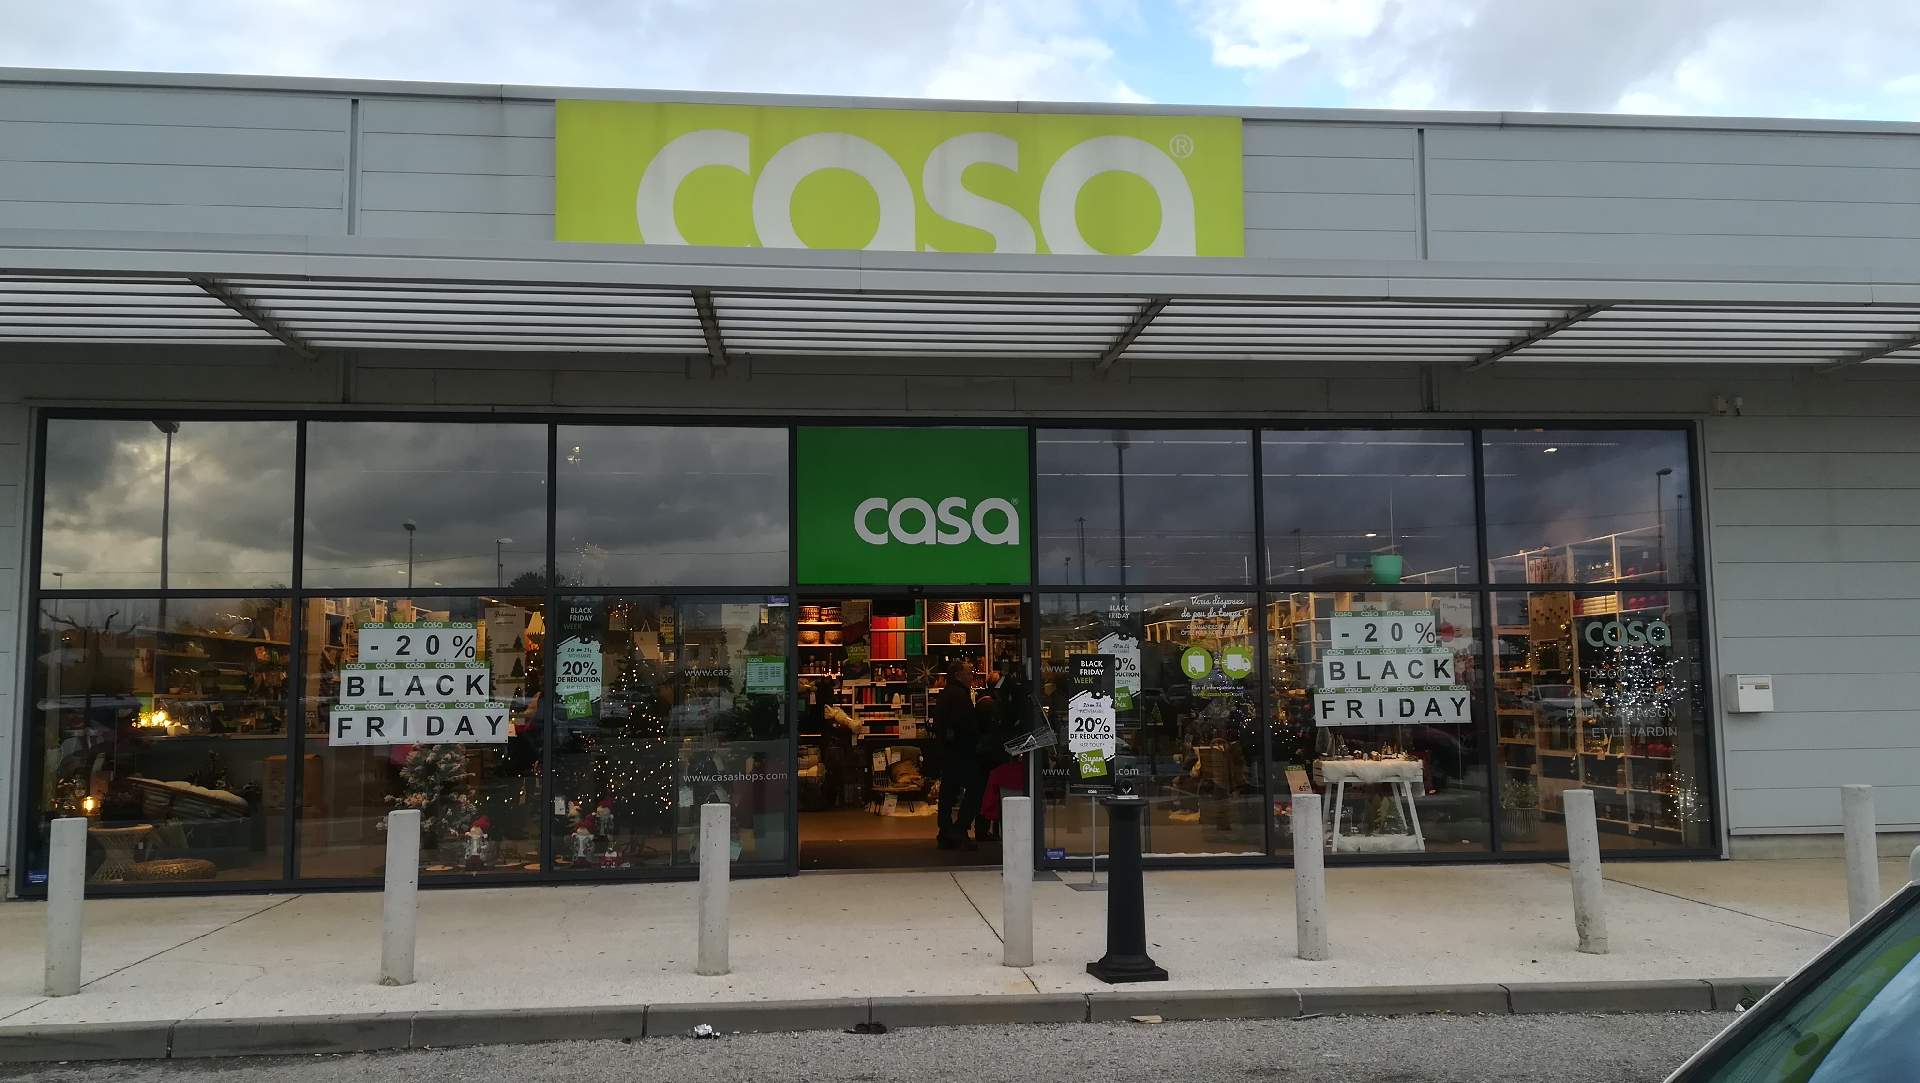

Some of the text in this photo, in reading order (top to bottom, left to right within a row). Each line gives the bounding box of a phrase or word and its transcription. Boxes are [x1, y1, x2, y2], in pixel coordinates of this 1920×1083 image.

[636, 129, 1197, 257] casa
[854, 497, 1020, 545] casa
[569, 614, 593, 622] FRIDAY
[1585, 621, 1672, 648] casa
[562, 661, 598, 676] 20%
[1079, 668, 1104, 676] FRIDAY
[1115, 657, 1136, 671] 0%
[1329, 658, 1451, 681] BLACK
[347, 674, 485, 697] BLACK
[1074, 676, 1094, 684] WEEK
[1321, 697, 1466, 719] FRIDAY
[338, 715, 503, 738] FRIDAY
[1075, 717, 1110, 733] 20%
[1632, 726, 1678, 737] JARDIN
[683, 772, 788, 783] www.casashops.com
